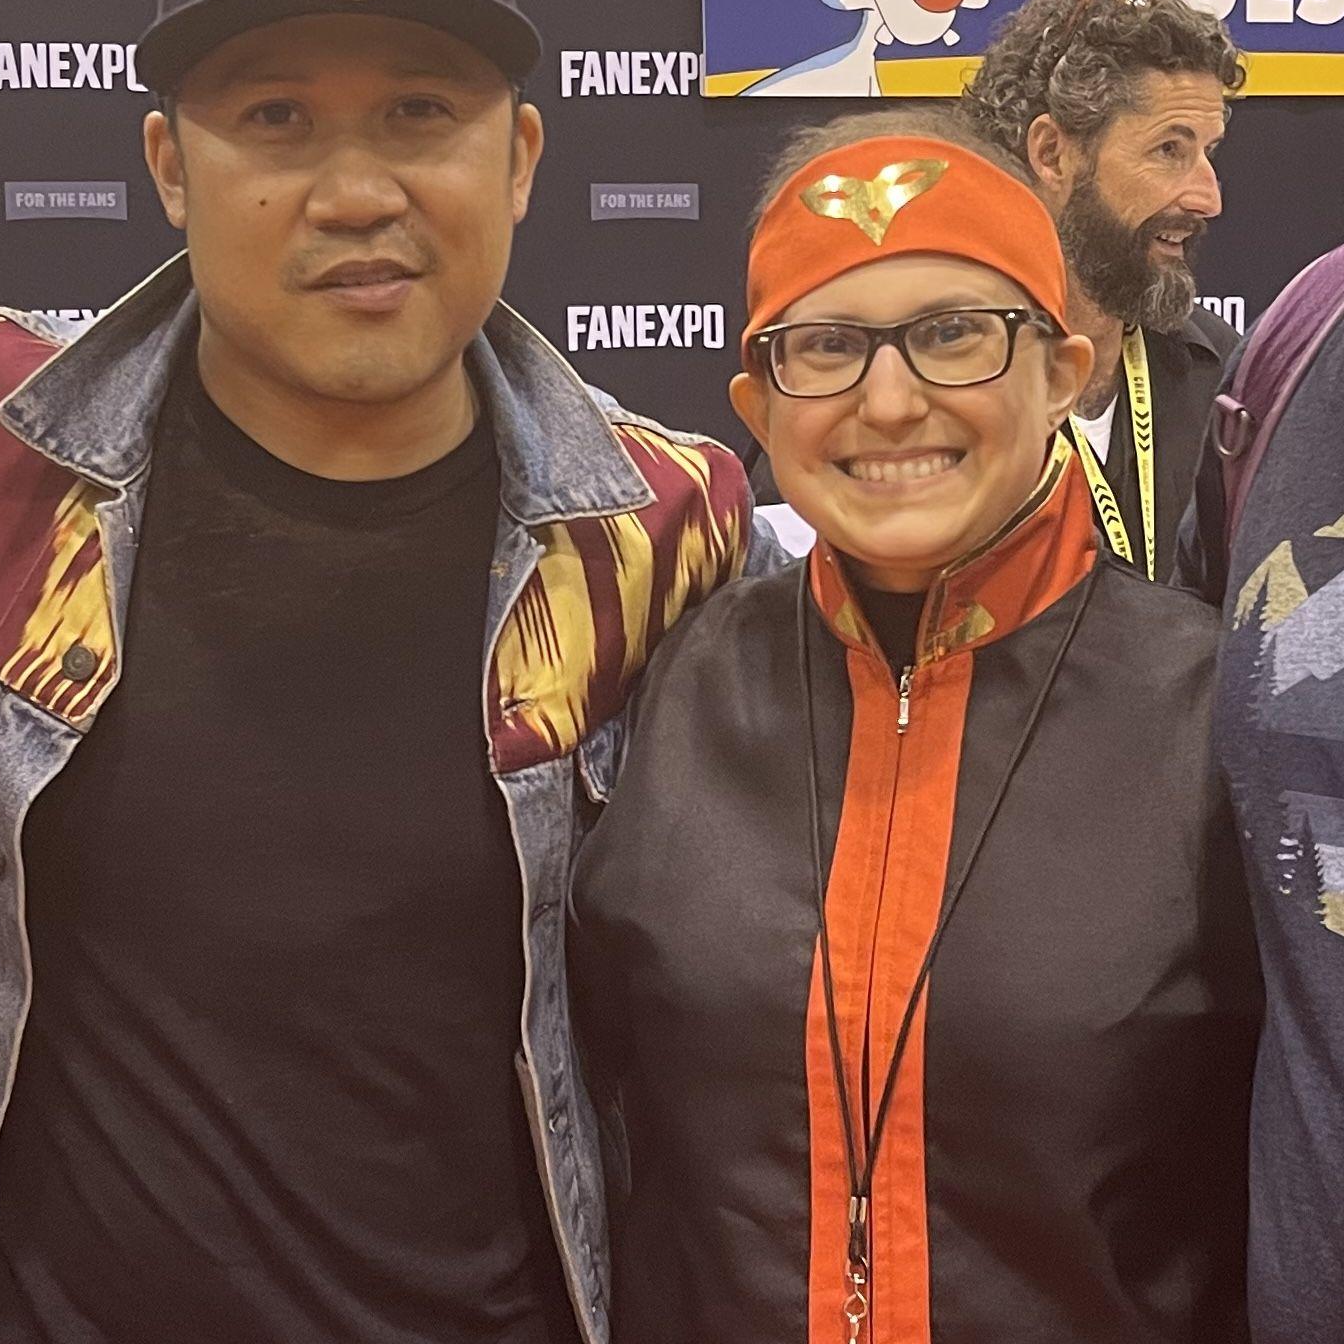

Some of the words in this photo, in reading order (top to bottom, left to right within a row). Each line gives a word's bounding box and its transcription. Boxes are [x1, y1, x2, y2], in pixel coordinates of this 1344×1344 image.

[561, 51, 703, 97] FANEXP
[15, 191, 42, 208] FOR
[45, 192, 73, 208] THE
[76, 193, 116, 208] FANS
[599, 193, 626, 208] FOR
[629, 193, 654, 207] THE
[656, 193, 691, 207] FANS
[566, 304, 725, 351] FANEXPO
